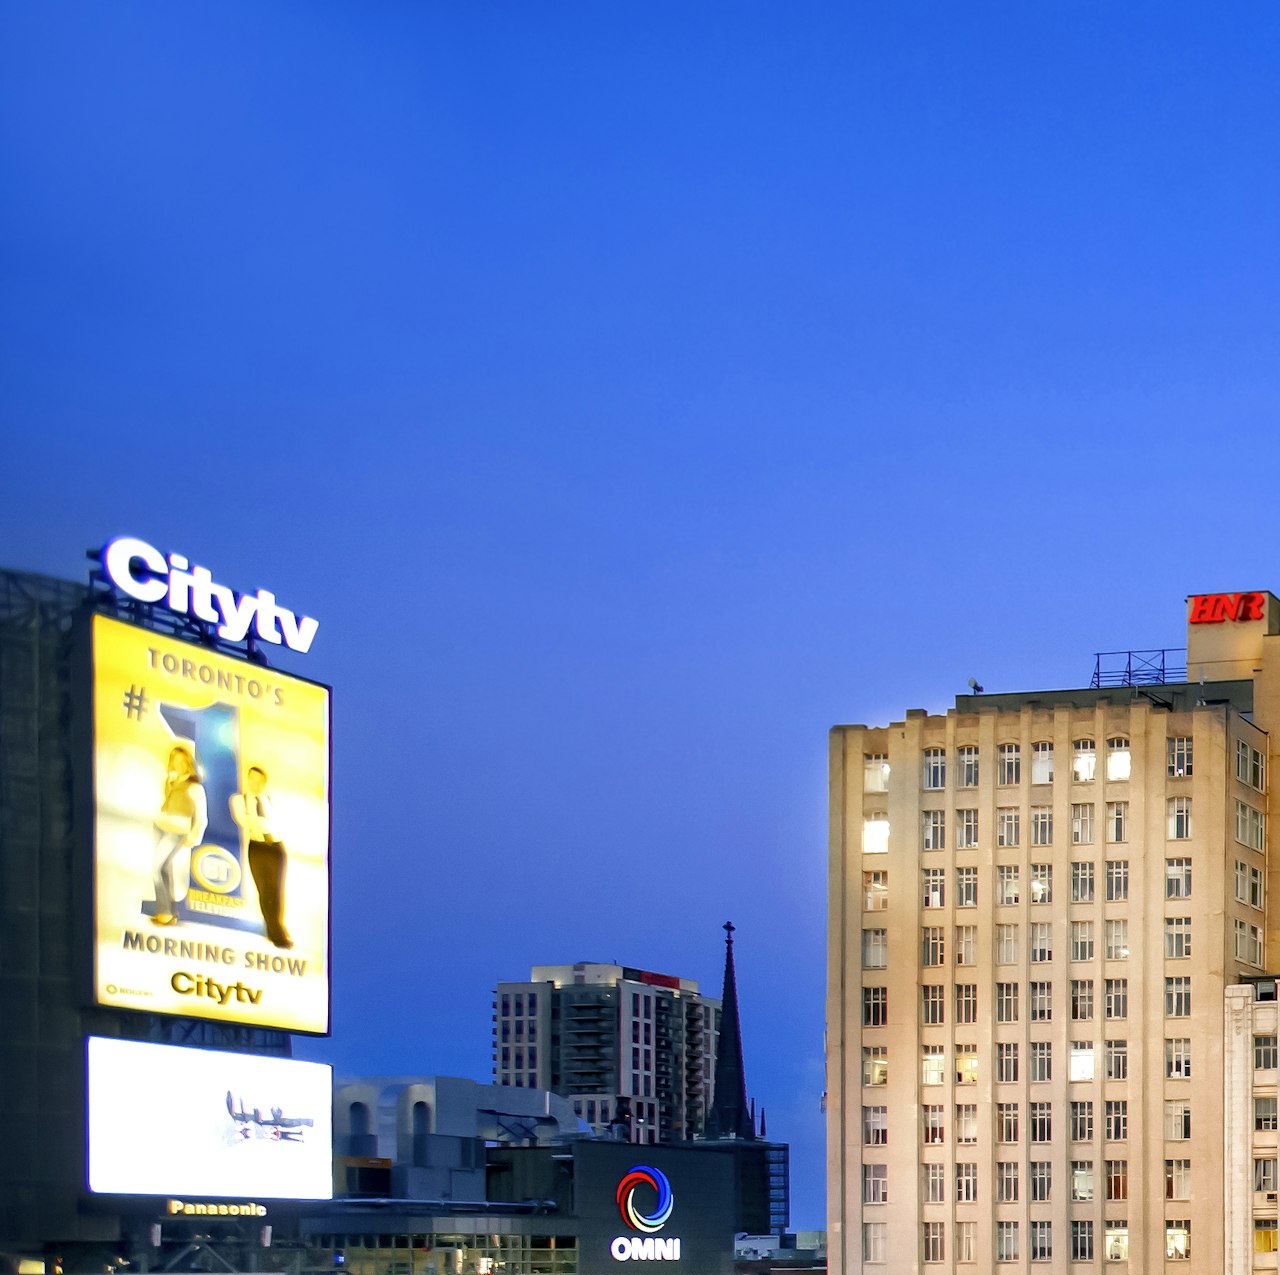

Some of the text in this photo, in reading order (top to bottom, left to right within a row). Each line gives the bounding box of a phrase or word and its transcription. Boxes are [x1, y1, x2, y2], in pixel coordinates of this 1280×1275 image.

[106, 537, 320, 653] Citytv
[147, 648, 285, 706] TORONTO'S
[123, 930, 307, 977] MORNING SHOW
[171, 972, 263, 1005] Citytv
[167, 1199, 267, 1217] Panasonic
[610, 1236, 681, 1261] OMNI
